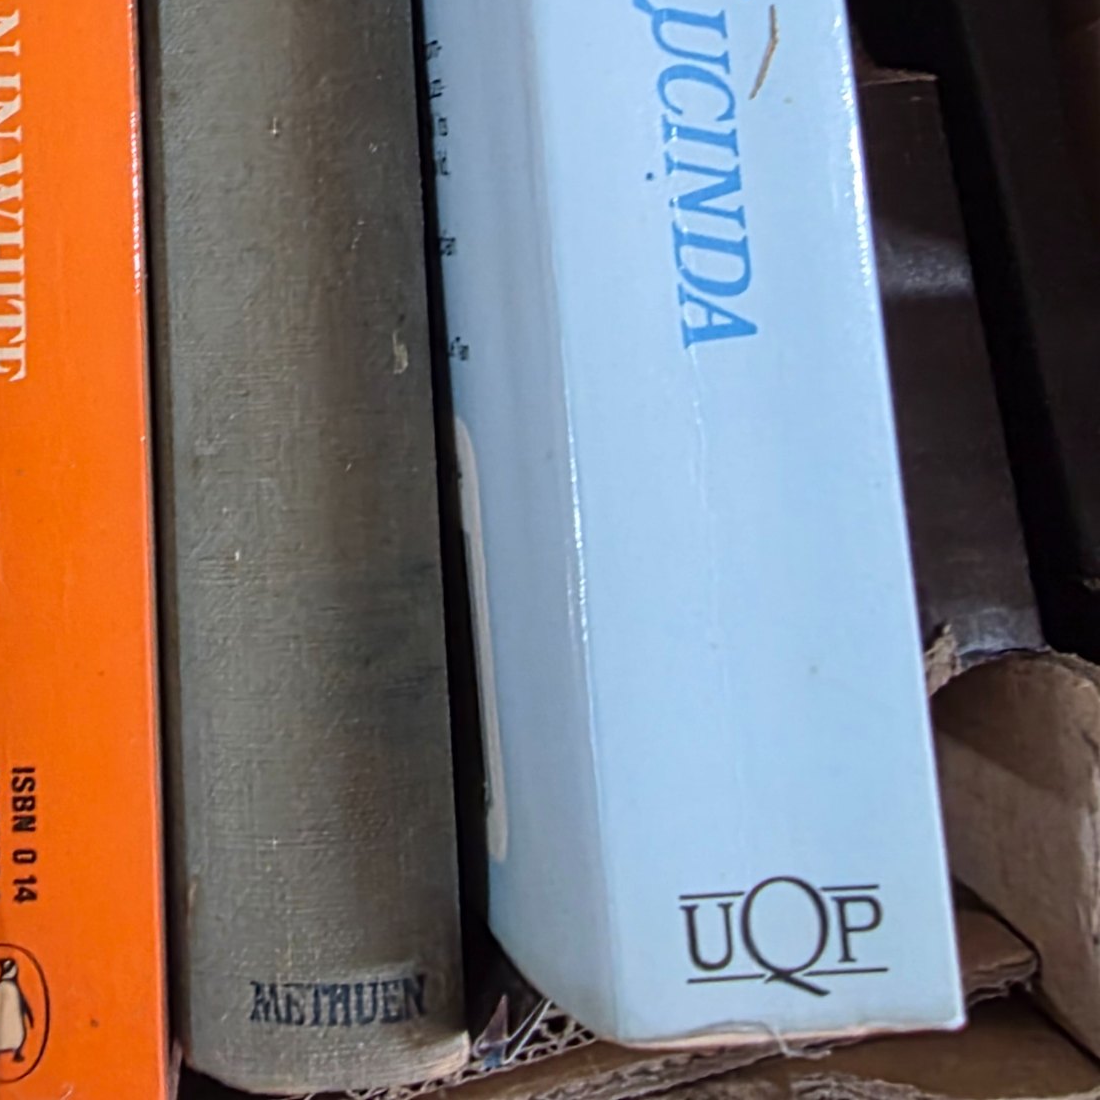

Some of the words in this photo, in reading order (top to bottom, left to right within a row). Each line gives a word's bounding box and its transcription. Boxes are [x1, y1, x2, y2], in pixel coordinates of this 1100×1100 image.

[11, 767, 36, 832] ISBN
[12, 849, 37, 864] 0
[13, 875, 37, 904] 14
[680, 877, 884, 996] UQP
[249, 974, 426, 1027] METHUEN
